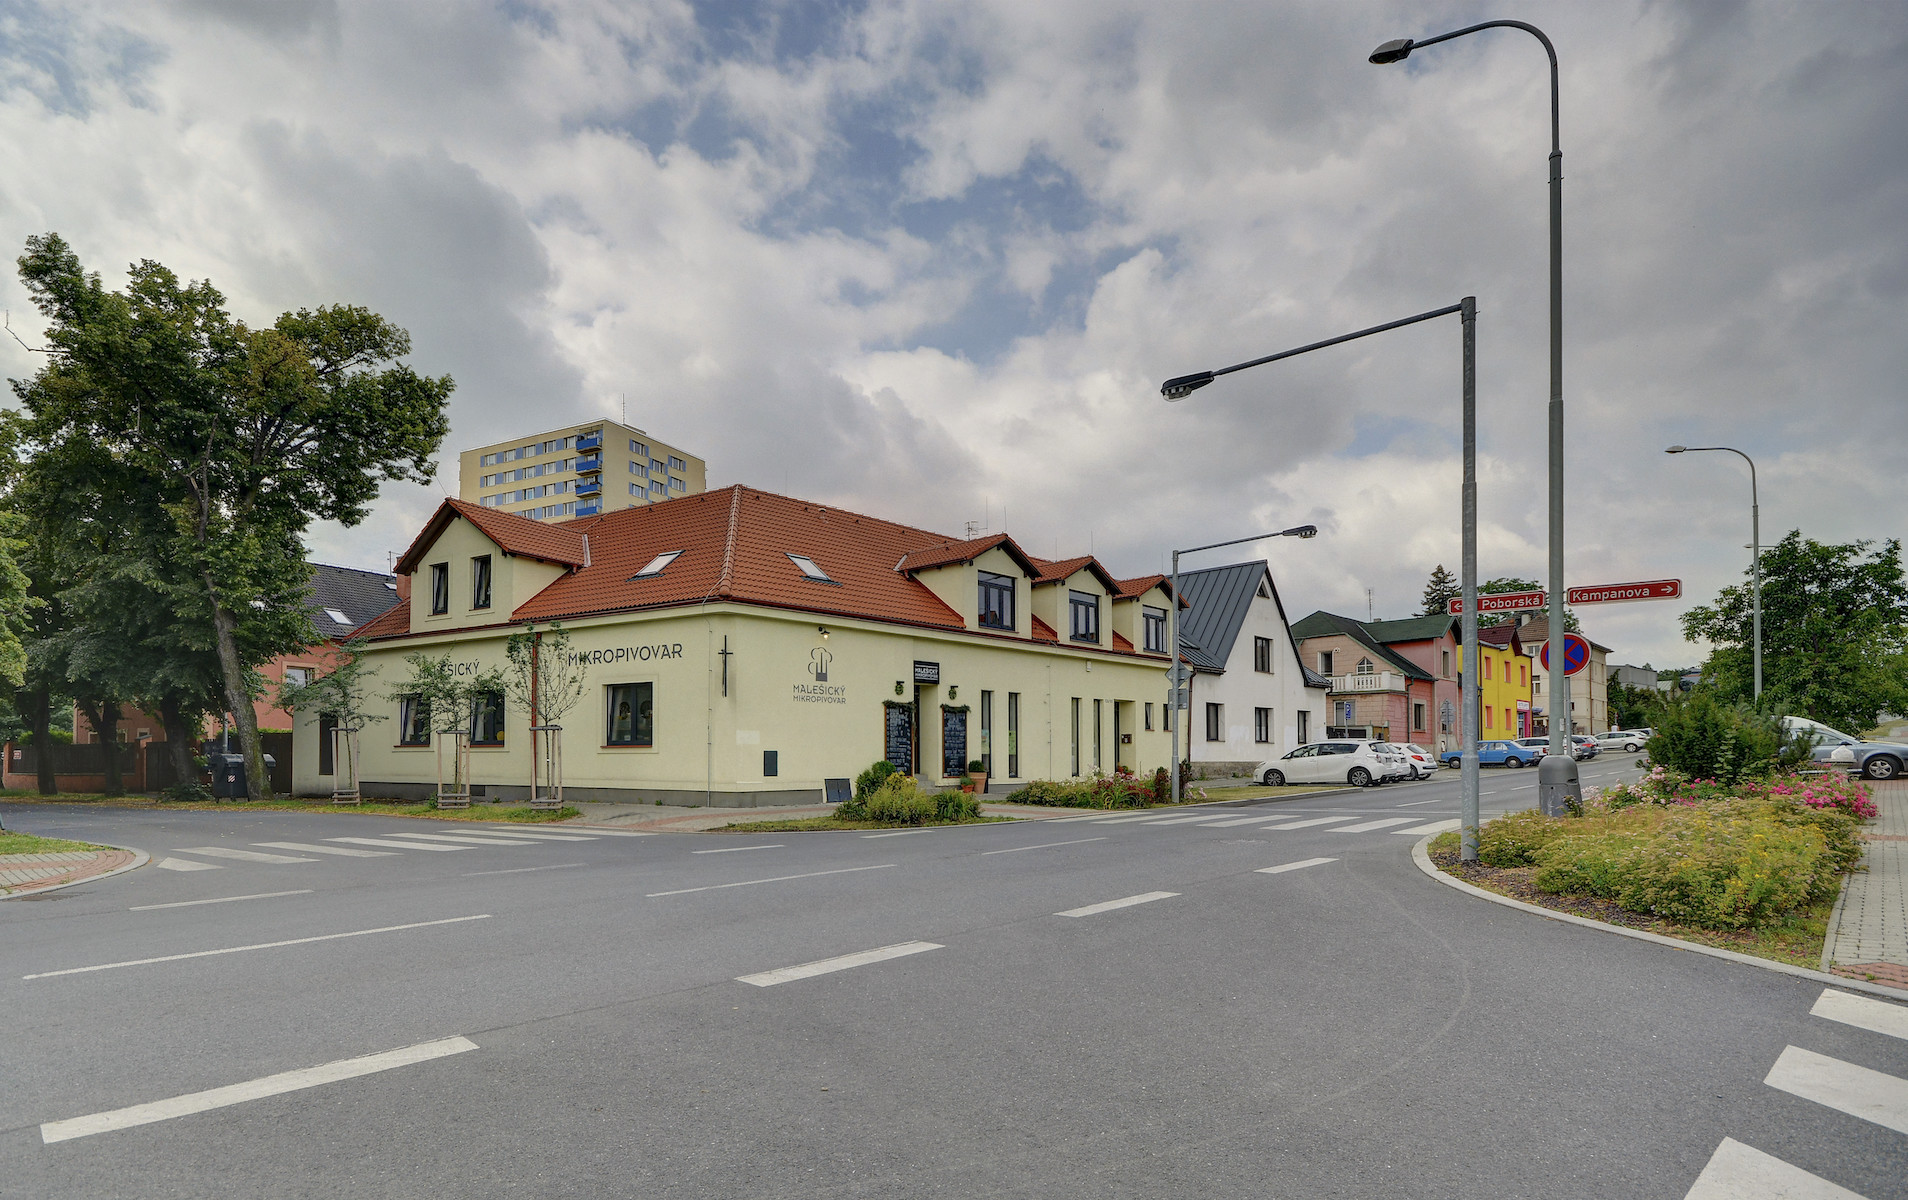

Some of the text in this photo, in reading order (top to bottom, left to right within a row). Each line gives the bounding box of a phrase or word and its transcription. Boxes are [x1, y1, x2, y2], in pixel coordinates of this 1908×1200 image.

[1482, 595, 1540, 609] Poborská
[1572, 588, 1650, 602] Kampanova
[568, 643, 683, 667] MIKROPIVOVAR
[793, 684, 846, 696] MALEŠICKÝ
[793, 695, 846, 705] MIKROPIVOVAR
